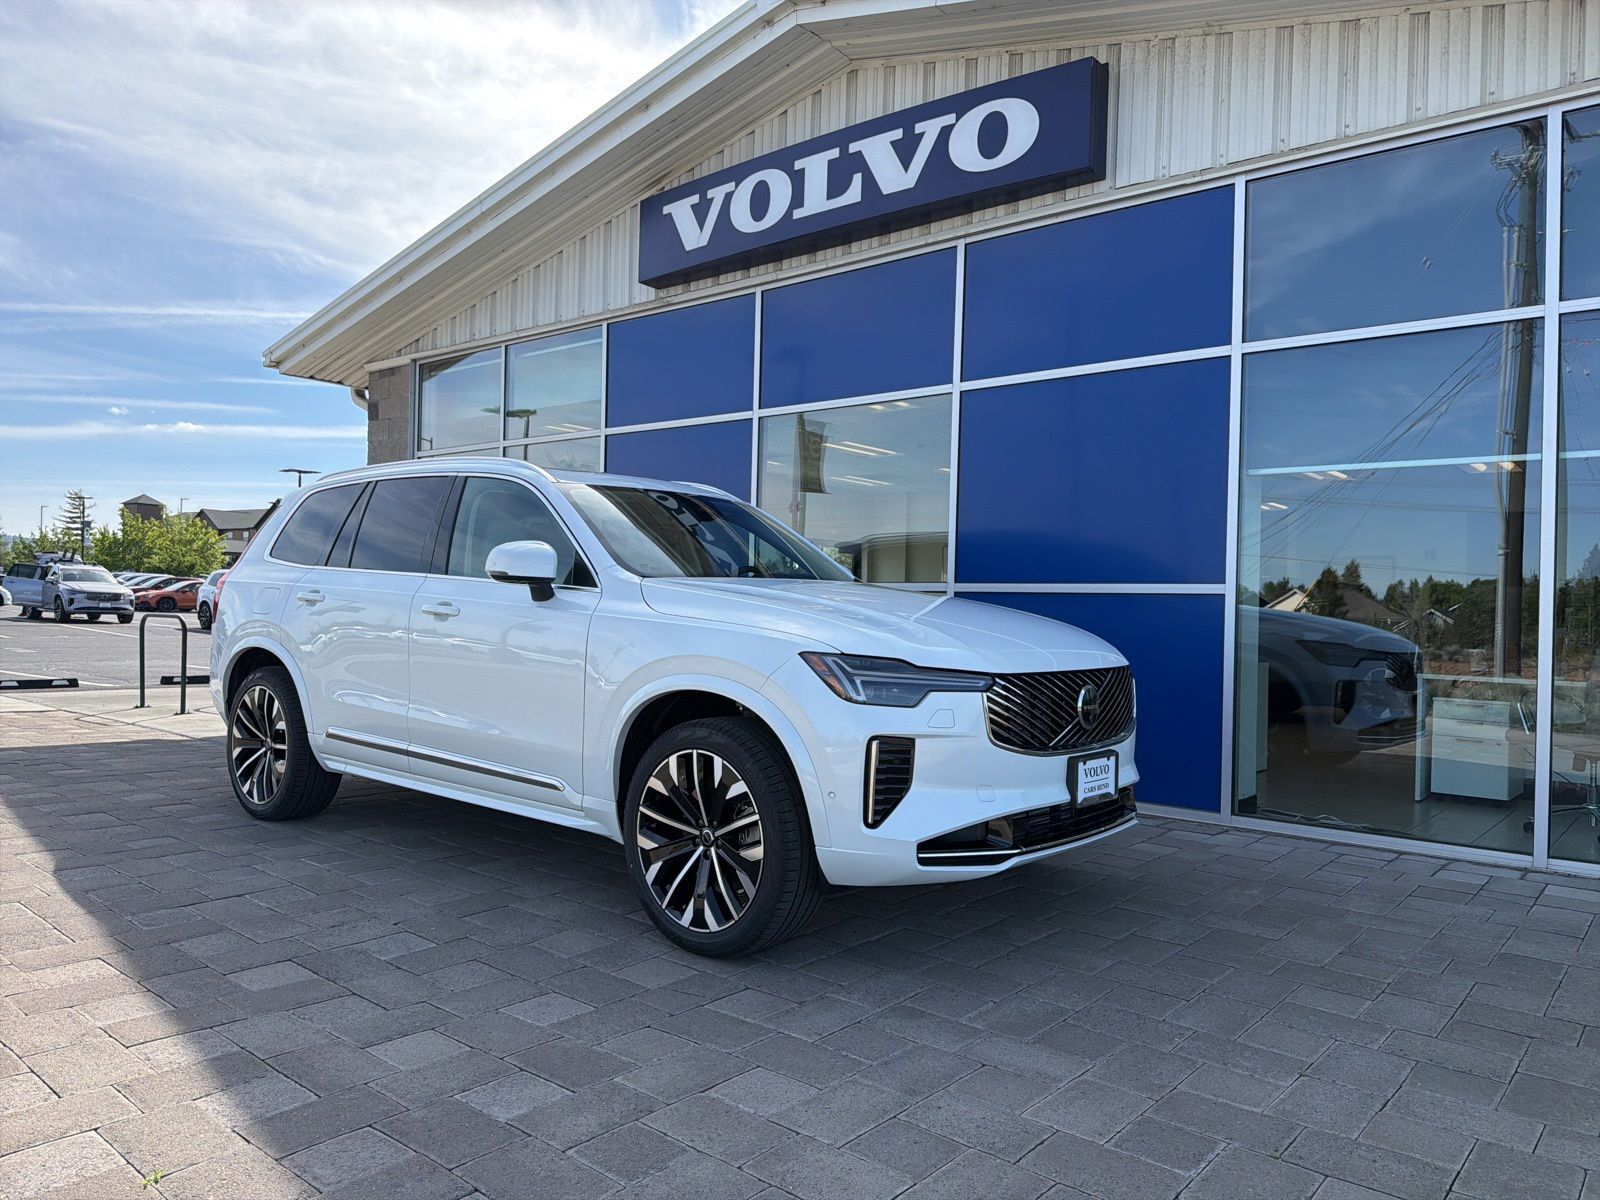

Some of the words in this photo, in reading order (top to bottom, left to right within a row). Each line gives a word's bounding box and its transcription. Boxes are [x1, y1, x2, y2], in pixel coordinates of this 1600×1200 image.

[662, 97, 1040, 252] VOLVO
[1083, 764, 1110, 778] VOLVO
[1083, 785, 1097, 794] CARS
